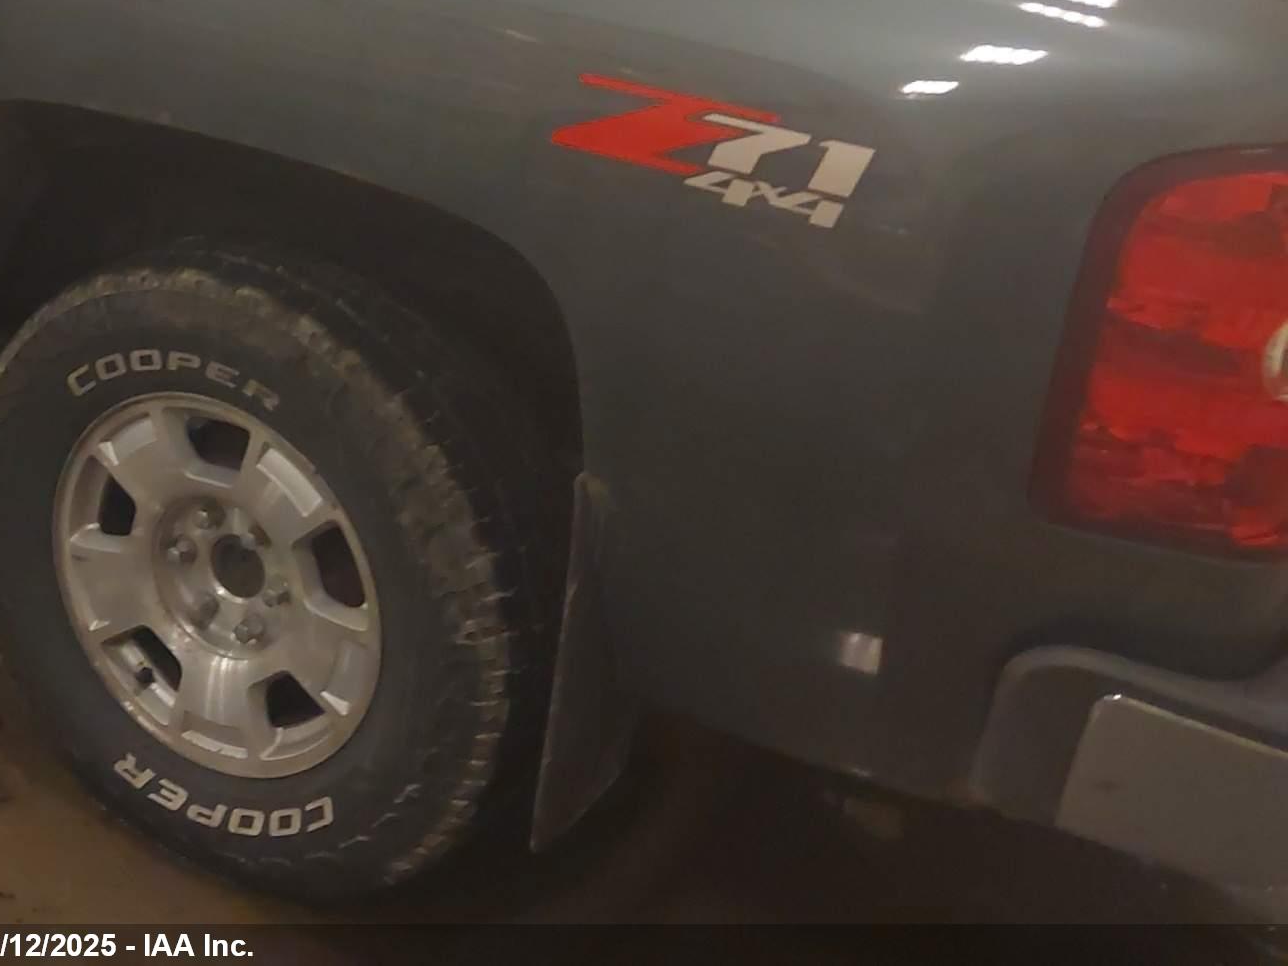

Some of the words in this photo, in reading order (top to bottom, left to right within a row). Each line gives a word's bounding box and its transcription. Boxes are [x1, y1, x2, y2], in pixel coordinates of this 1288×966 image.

[551, 73, 876, 198] Z71
[66, 348, 280, 412] COOPER
[113, 752, 334, 837] COOPER
